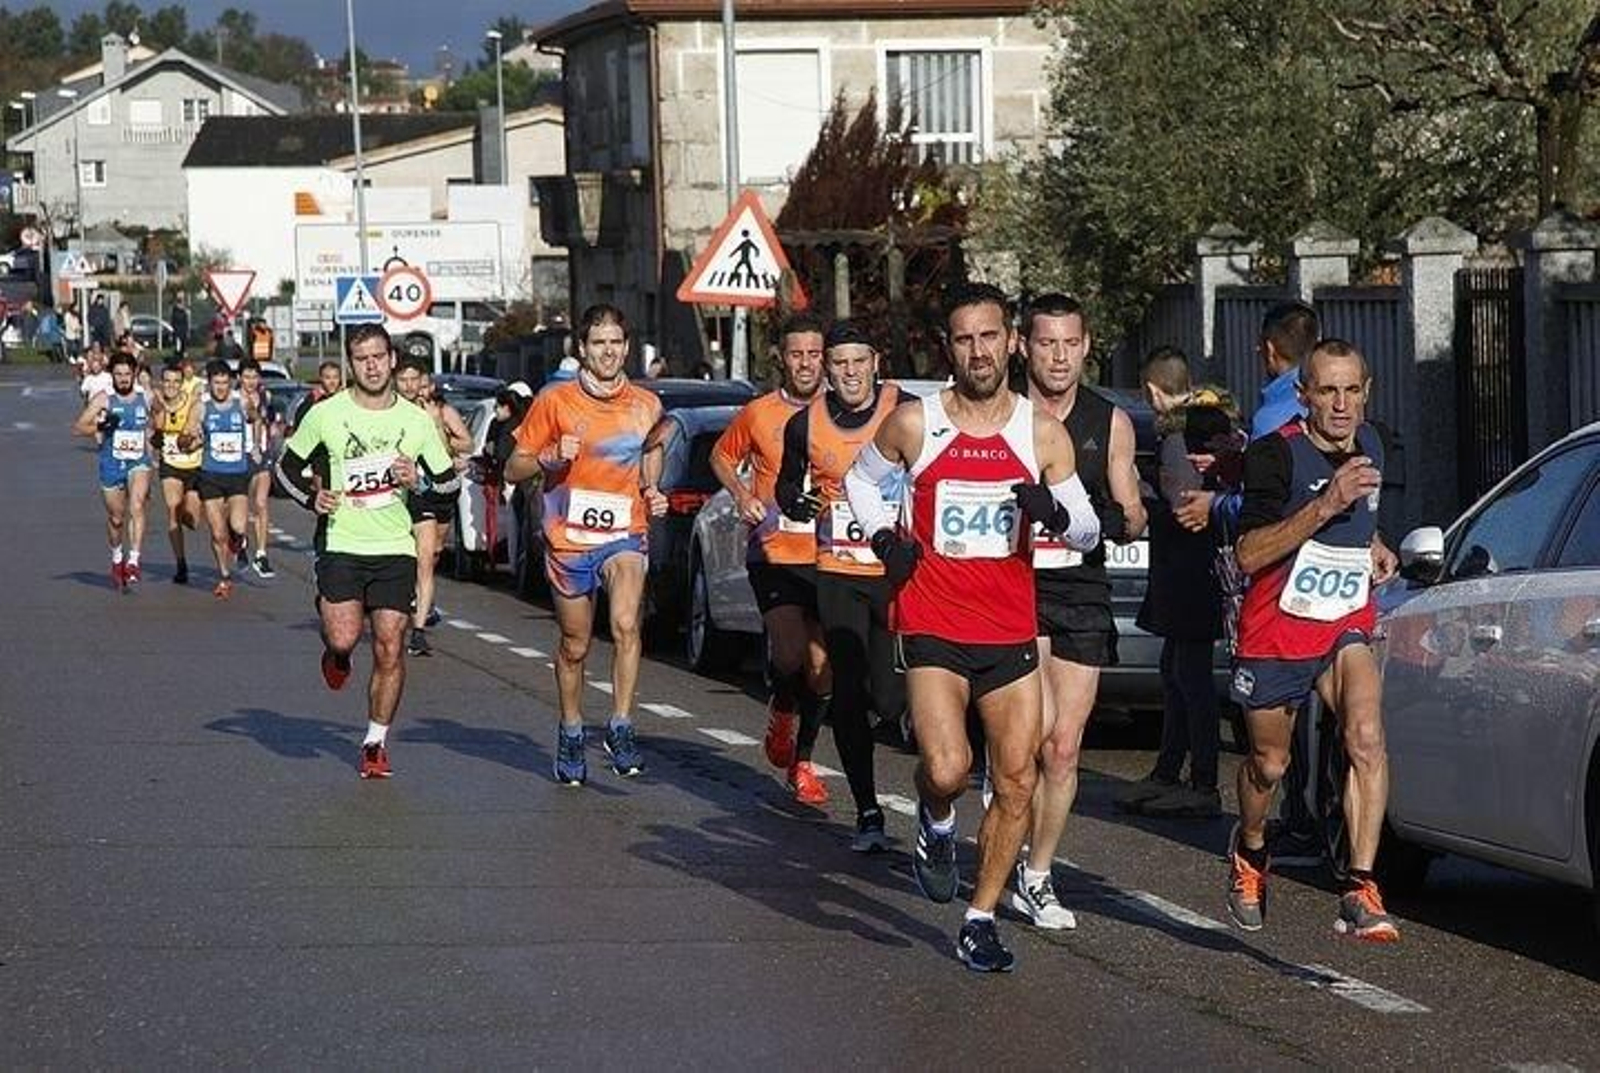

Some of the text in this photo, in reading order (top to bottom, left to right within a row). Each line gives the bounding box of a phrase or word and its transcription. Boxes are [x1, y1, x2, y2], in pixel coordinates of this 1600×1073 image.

[388, 284, 421, 302] 40
[949, 448, 1008, 460] O BARCO
[348, 467, 399, 493] 254
[582, 507, 615, 530] 69
[941, 505, 1016, 536] 646
[846, 520, 869, 542] 6
[1294, 566, 1364, 599] 605
